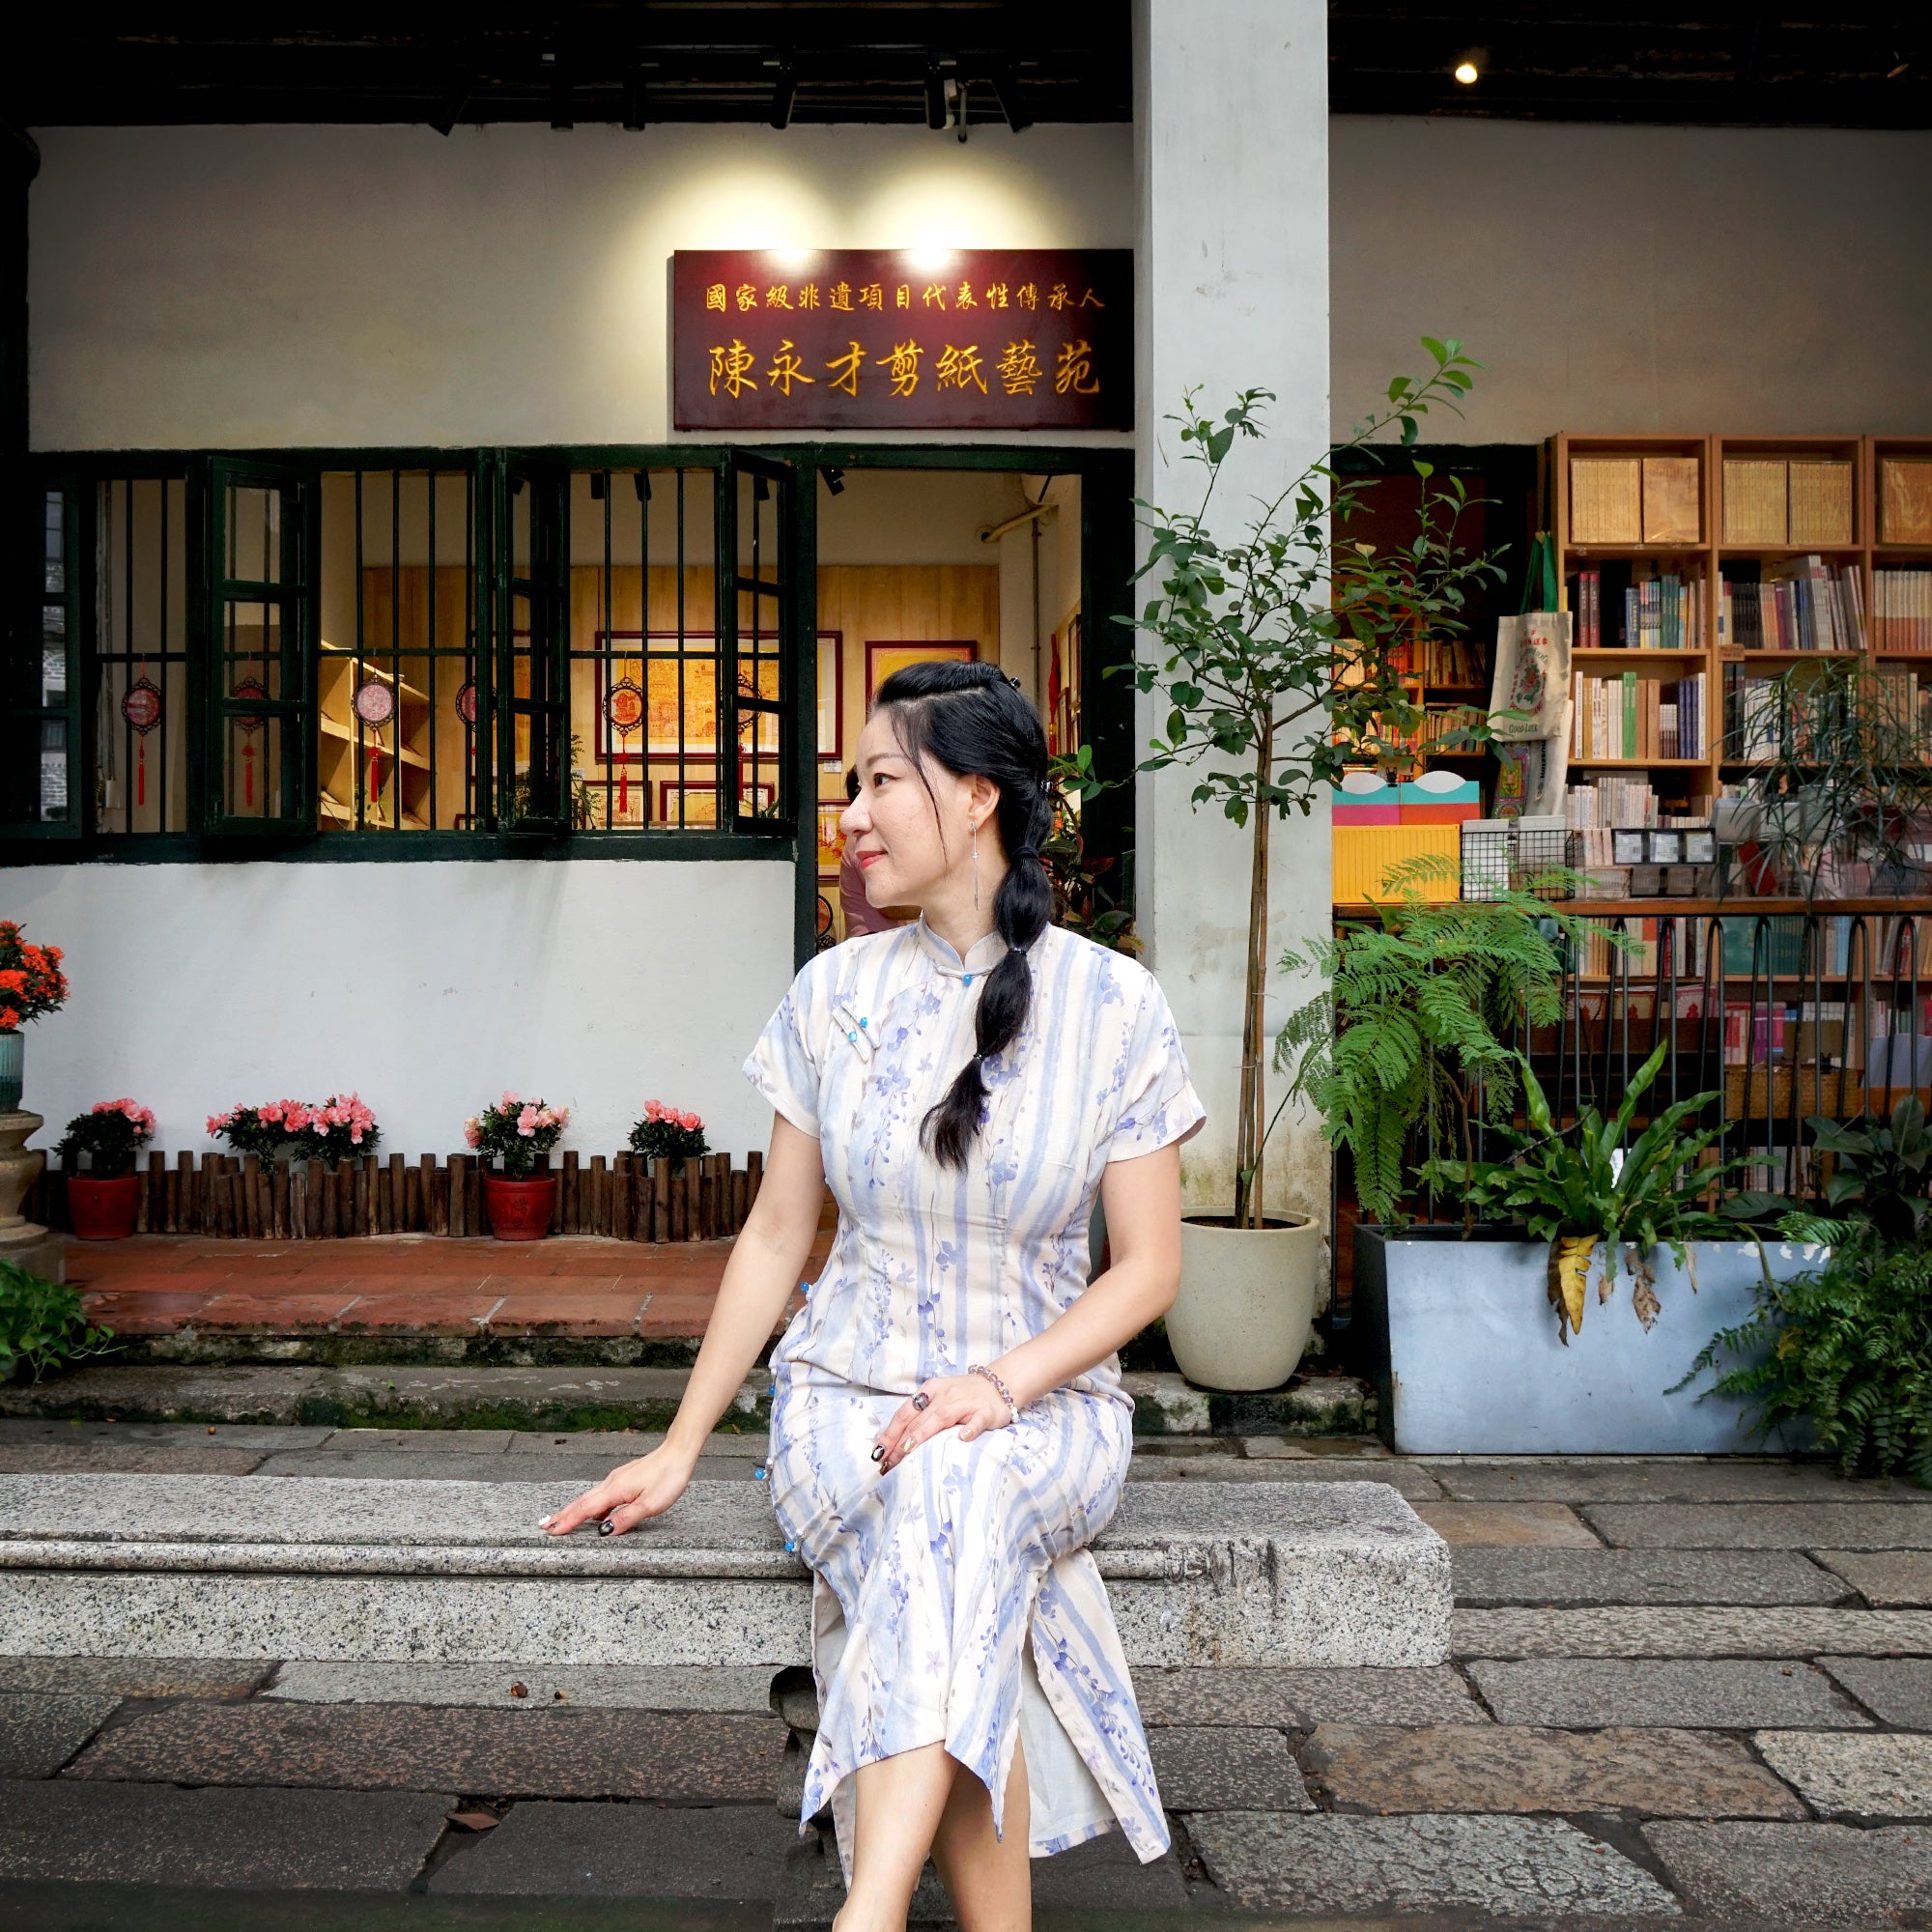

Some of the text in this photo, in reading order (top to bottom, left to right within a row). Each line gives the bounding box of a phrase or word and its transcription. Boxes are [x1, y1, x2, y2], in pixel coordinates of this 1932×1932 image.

[706, 282, 1106, 312] 國家級非遺項目代表性傳承人
[708, 338, 1100, 399] 陳永才剪紙藝苑
